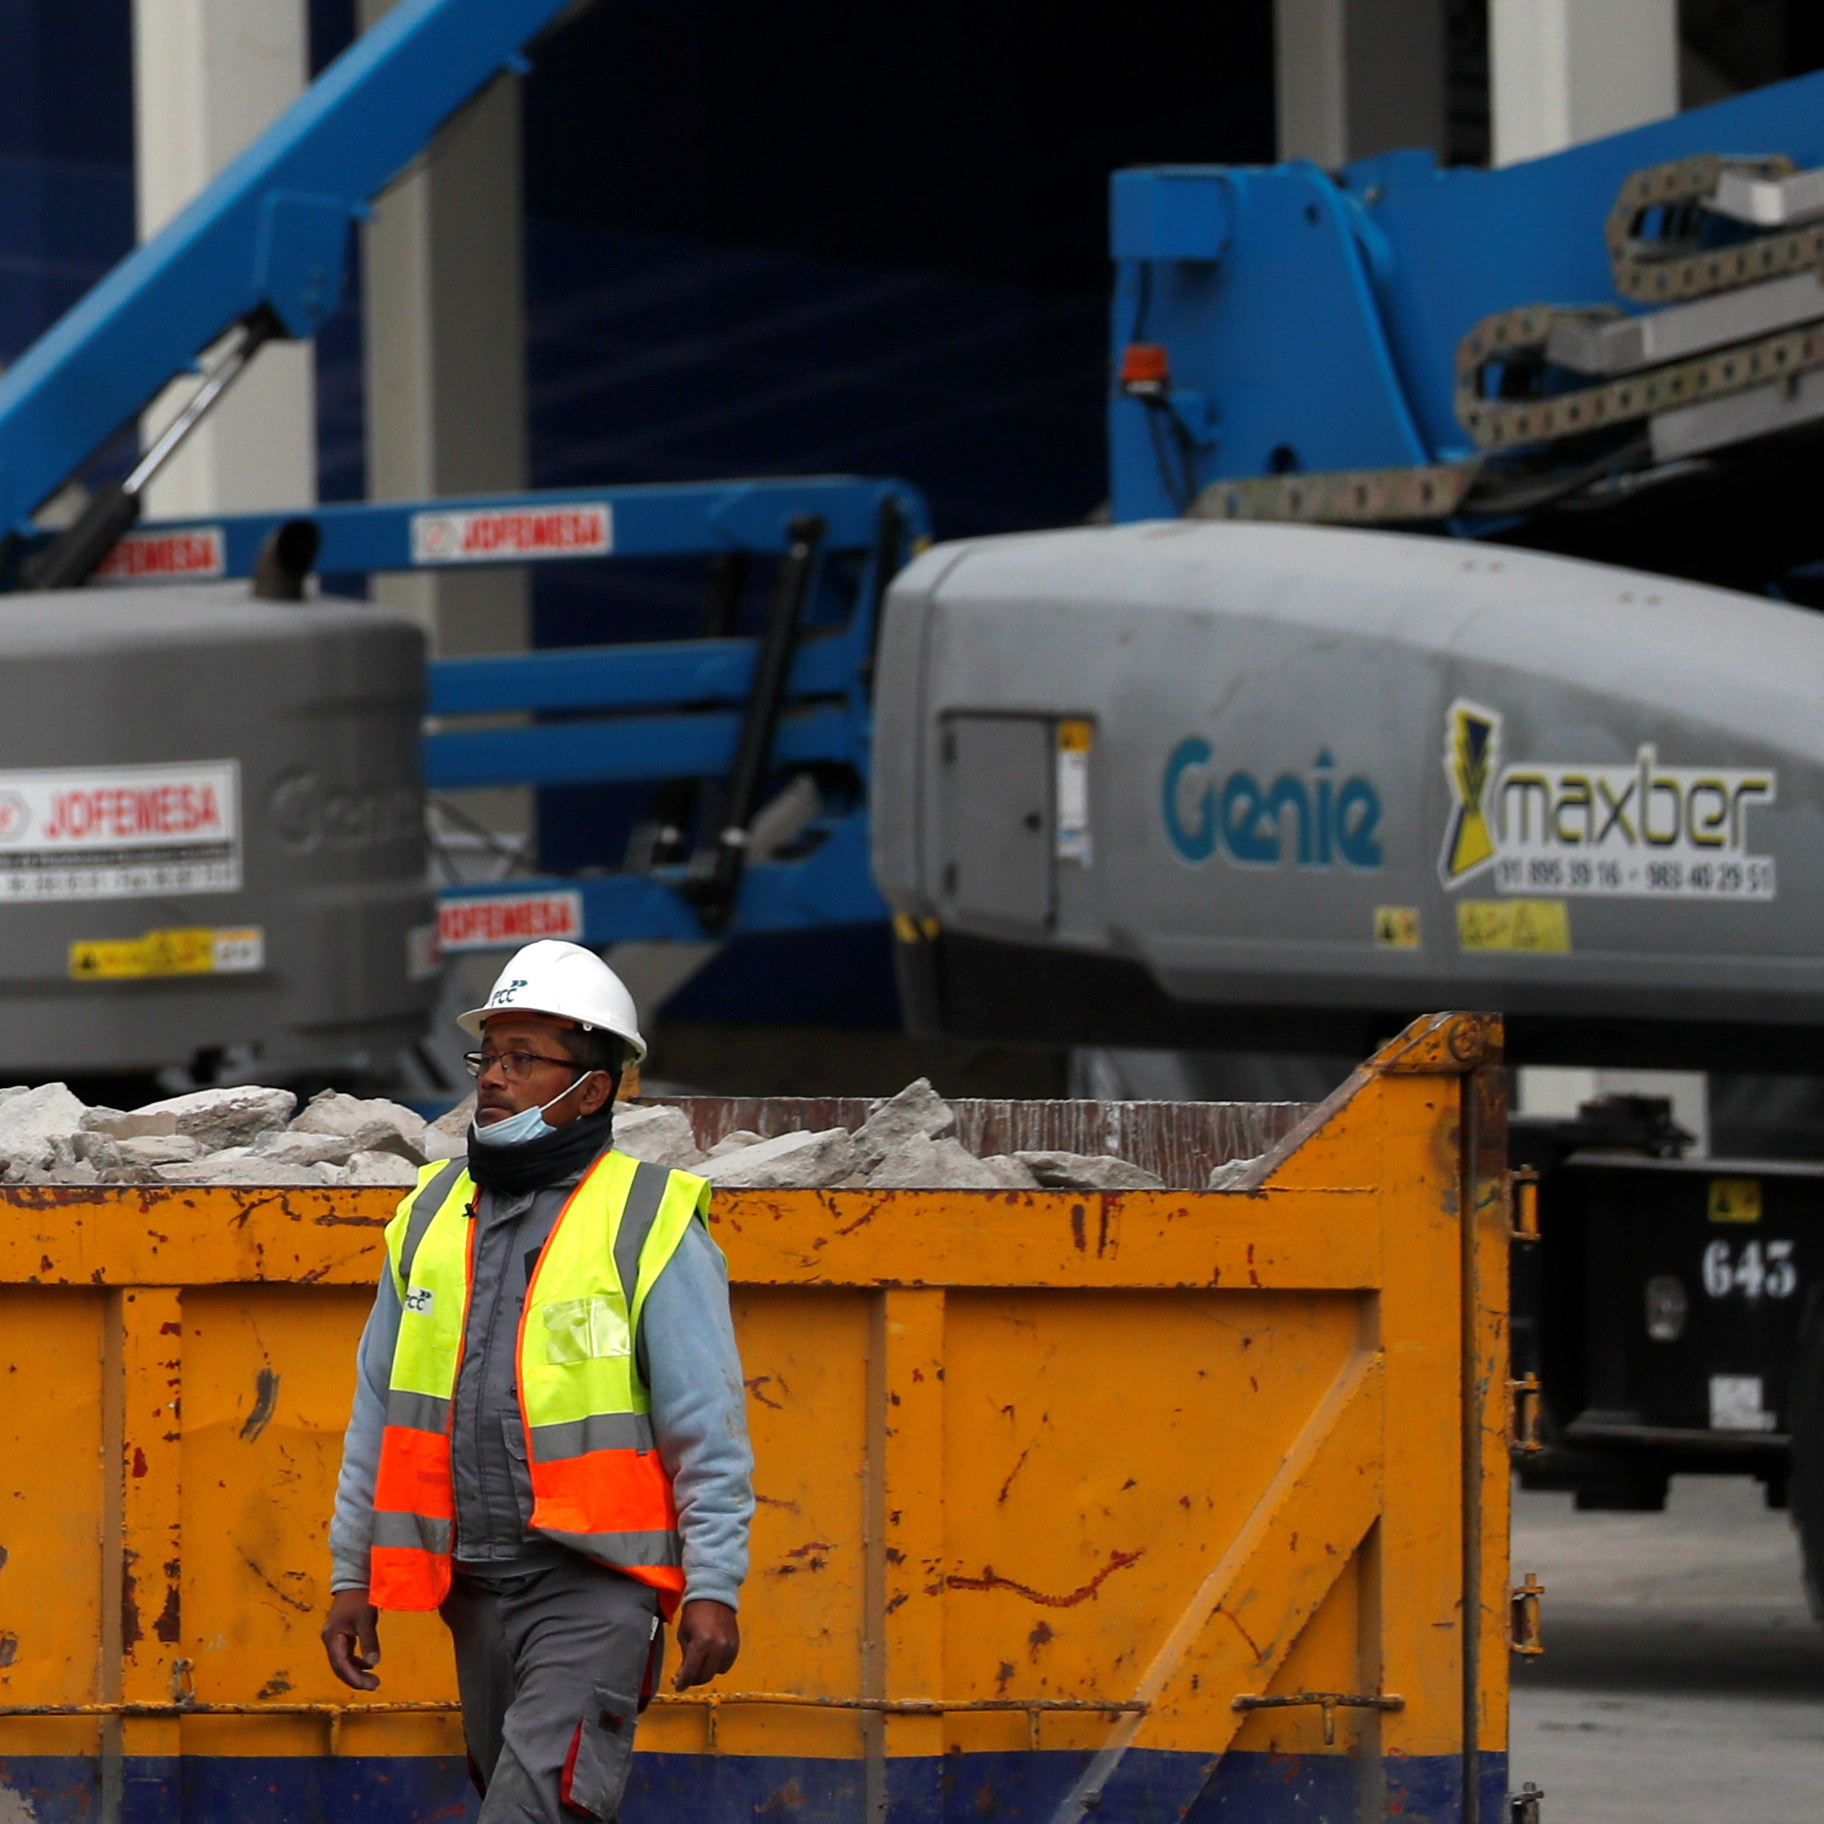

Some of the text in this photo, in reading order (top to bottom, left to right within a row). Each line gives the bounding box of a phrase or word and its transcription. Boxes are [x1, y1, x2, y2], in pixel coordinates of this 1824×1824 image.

[43, 783, 221, 838] JOFEMESA
[1162, 734, 1383, 867] Genie
[1504, 754, 1769, 849] maxber
